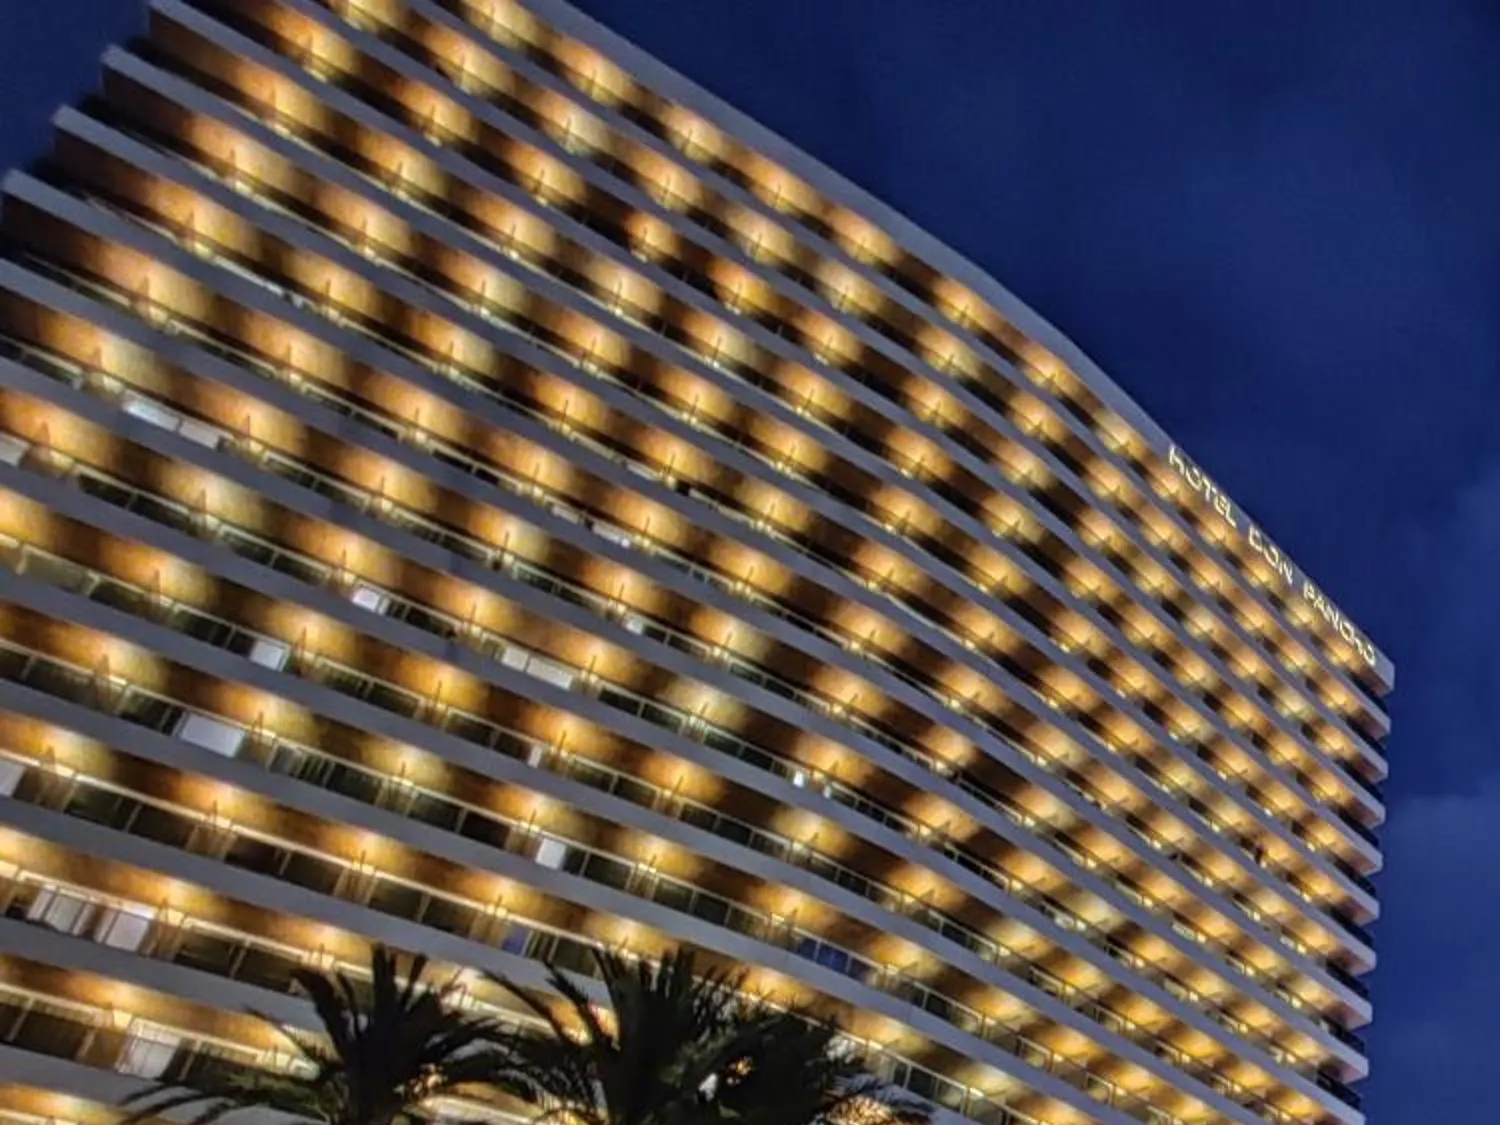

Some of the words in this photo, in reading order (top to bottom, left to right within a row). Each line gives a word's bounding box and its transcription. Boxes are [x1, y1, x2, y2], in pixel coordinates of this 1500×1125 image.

[1168, 444, 1237, 527] HOTEL
[1248, 522, 1294, 585] DON
[1303, 579, 1376, 666] PANCHO
